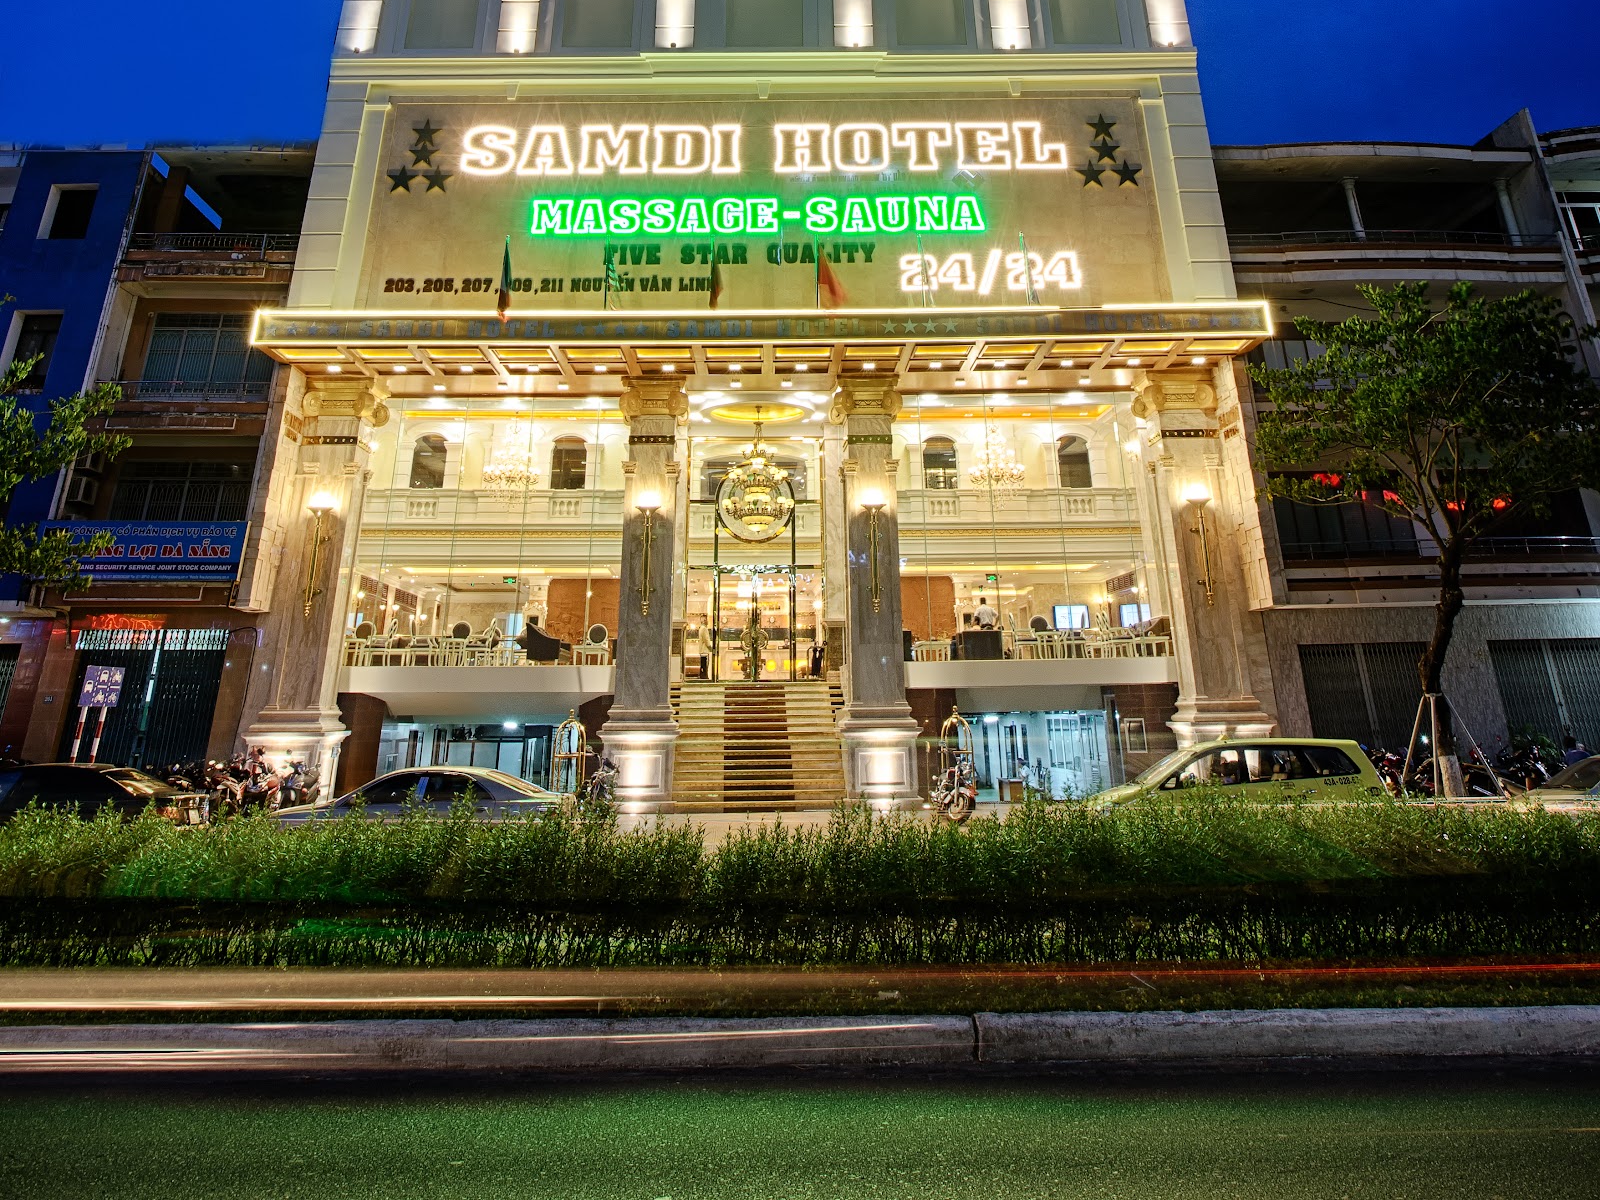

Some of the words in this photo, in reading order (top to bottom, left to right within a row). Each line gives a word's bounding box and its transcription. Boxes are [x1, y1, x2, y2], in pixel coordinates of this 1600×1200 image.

[460, 123, 742, 176] SAMDI
[773, 121, 1069, 173] HOTEL
[531, 196, 986, 235] MASSAGE-SAUNA
[680, 243, 747, 265] STAR
[384, 278, 563, 295] 203,205,207,09,211
[570, 272, 634, 293] NGUN
[639, 274, 672, 292] VĂN
[900, 249, 1083, 296] 24/24
[358, 319, 445, 338] SAMDI
[467, 319, 555, 338] HOTEL
[667, 318, 753, 338] SAMDI
[776, 317, 866, 337] HOTEL
[976, 313, 1062, 334] SAMDI
[1084, 312, 1173, 331] HOTEL
[160, 527, 185, 538] DỊCH
[186, 527, 200, 539] VỤ
[157, 564, 176, 572] JOINT
